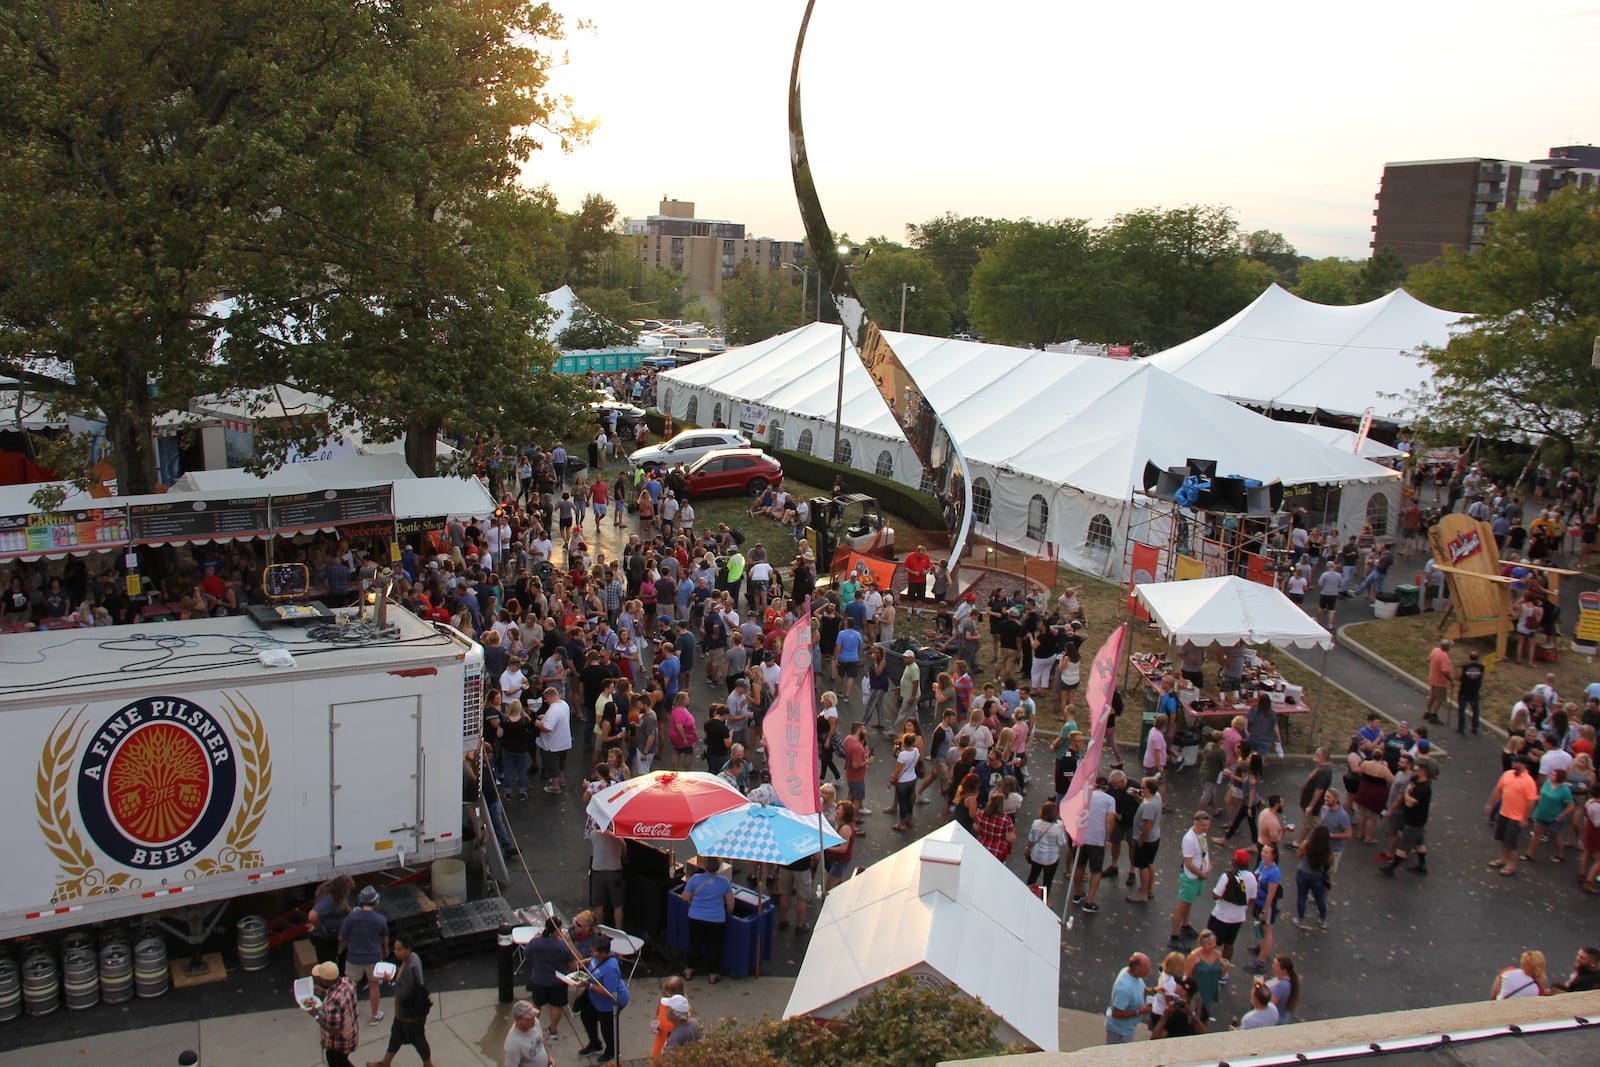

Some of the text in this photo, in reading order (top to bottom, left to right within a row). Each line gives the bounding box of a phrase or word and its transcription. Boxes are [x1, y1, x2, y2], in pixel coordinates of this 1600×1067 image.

[396, 520, 444, 534] Bottle Shop
[84, 700, 230, 781] A FINE PILSNER
[130, 839, 198, 866] BEER
